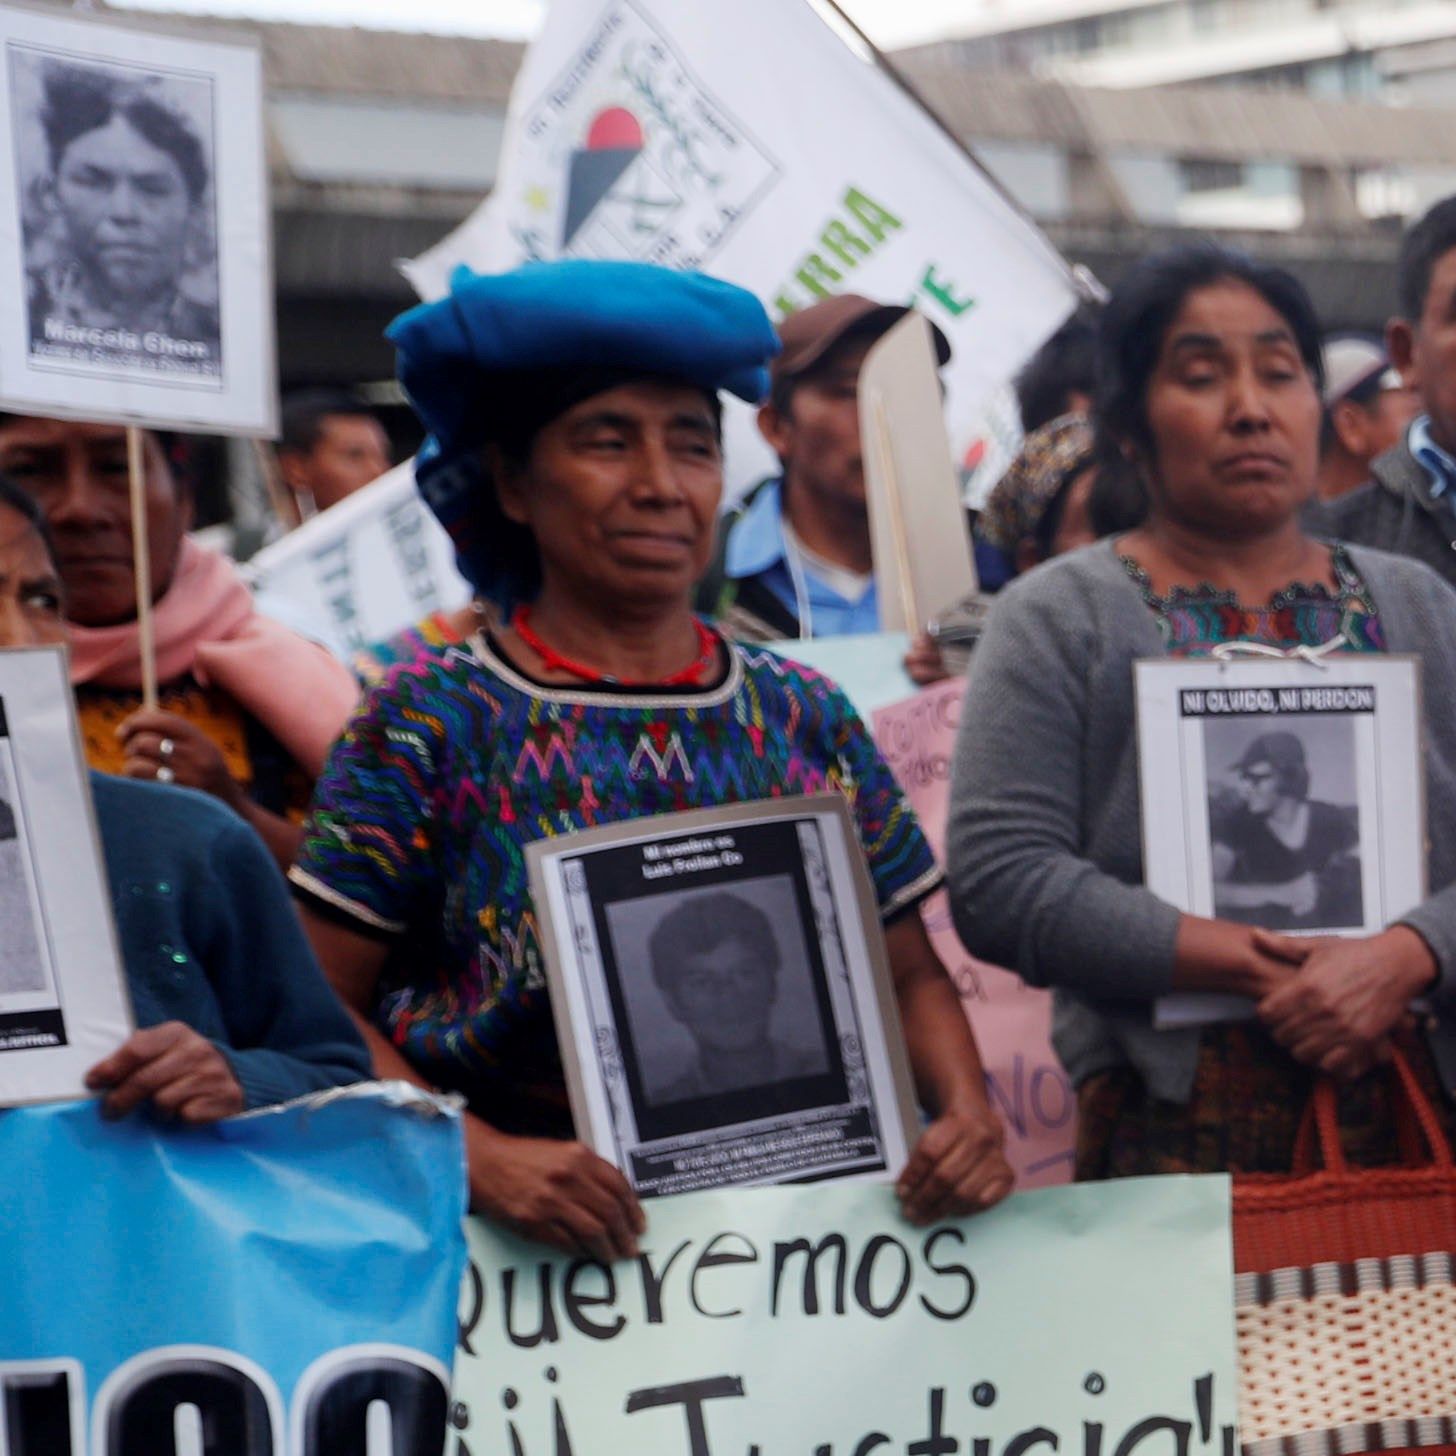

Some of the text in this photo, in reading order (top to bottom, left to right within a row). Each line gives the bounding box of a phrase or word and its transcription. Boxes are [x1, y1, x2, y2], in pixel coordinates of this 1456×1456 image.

[1183, 691, 1204, 714] NI
[1206, 689, 1278, 714] OLVIDO,
[1278, 688, 1299, 712] NI
